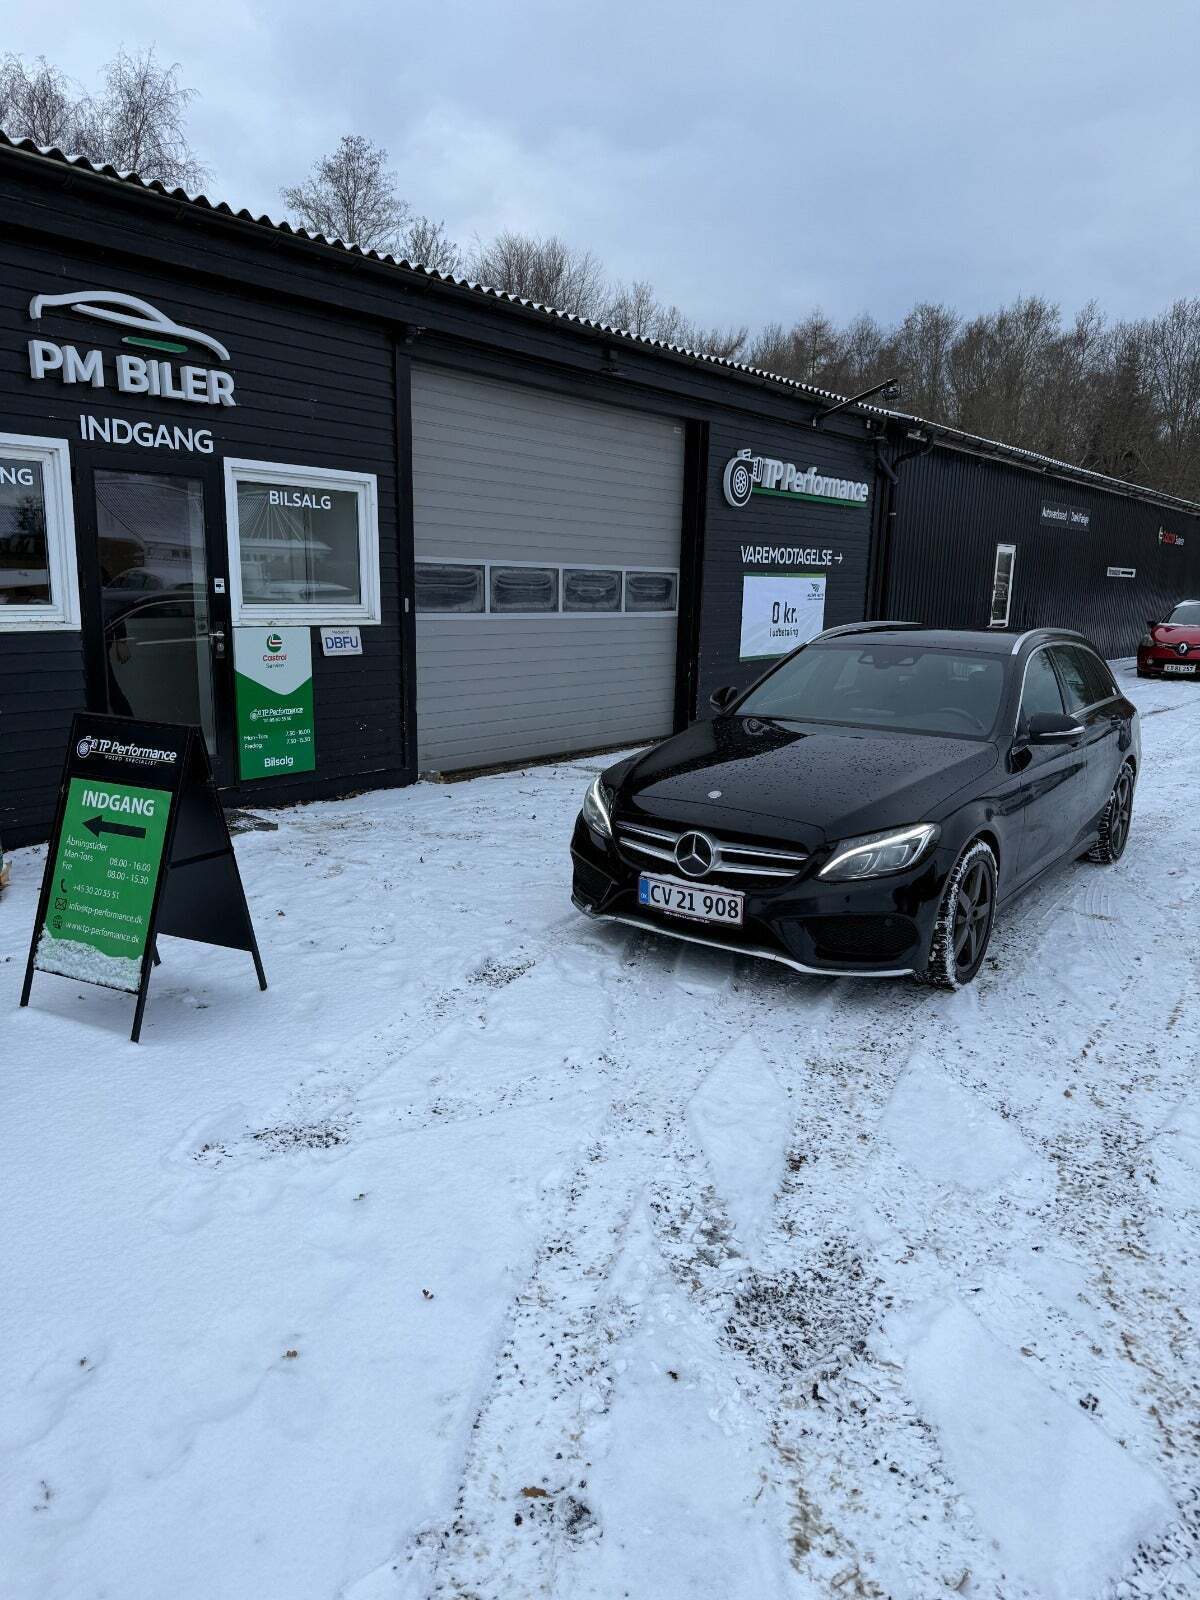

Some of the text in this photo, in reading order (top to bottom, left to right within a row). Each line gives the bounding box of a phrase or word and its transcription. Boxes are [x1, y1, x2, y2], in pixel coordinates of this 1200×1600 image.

[28, 339, 236, 406] PM BILER
[80, 414, 214, 454] INDGANG
[761, 457, 869, 503] TP Performance
[268, 489, 332, 510] BILSALG
[740, 545, 833, 566] VAREMODTAGELSE
[771, 600, 798, 624] 0 kr.
[324, 635, 359, 650] DBFU
[773, 627, 799, 639] udbetaling
[262, 653, 288, 662] Castrol
[269, 707, 304, 717] Performance
[99, 739, 177, 761] TP Performance
[104, 753, 157, 766] VOLVO SPECIALIST
[264, 755, 294, 768] Bilsalg
[81, 789, 155, 817] INDGANG
[131, 874, 150, 885] 15.30
[650, 884, 672, 906] CV
[676, 890, 696, 912] 21
[702, 895, 739, 919] 908
[64, 921, 140, 944] www.tp-performance.dk
